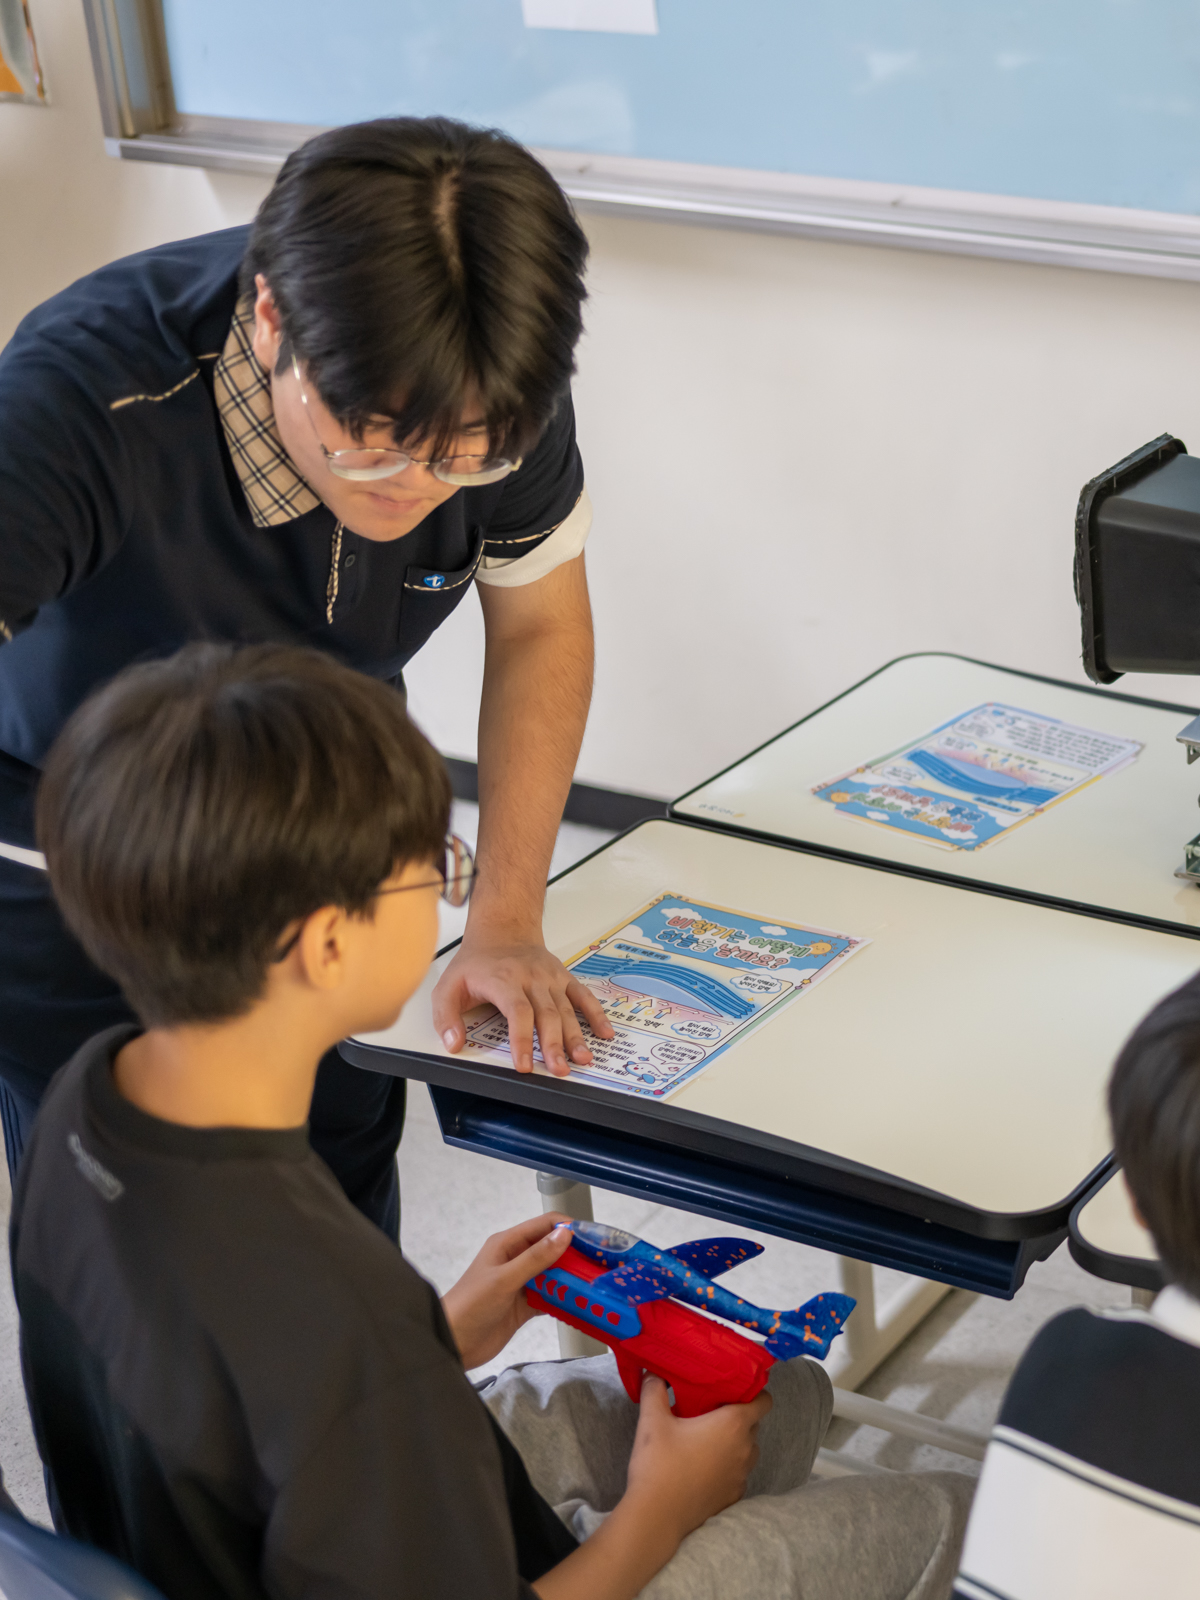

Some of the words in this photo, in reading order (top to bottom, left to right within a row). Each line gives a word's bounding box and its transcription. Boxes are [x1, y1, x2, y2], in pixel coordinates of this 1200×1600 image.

[668, 916, 746, 943] 비행기는
[749, 938, 811, 957] 어떻게
[657, 930, 715, 952] 하늘을
[716, 944, 788, 968] 날까요?
[756, 978, 777, 987] 약해요!
[756, 984, 771, 992] 압력
[610, 1011, 625, 1019] 뜨는
[698, 1031, 712, 1039] 압력
[590, 1040, 609, 1048] 압력이
[614, 1039, 636, 1047] 느려요!
